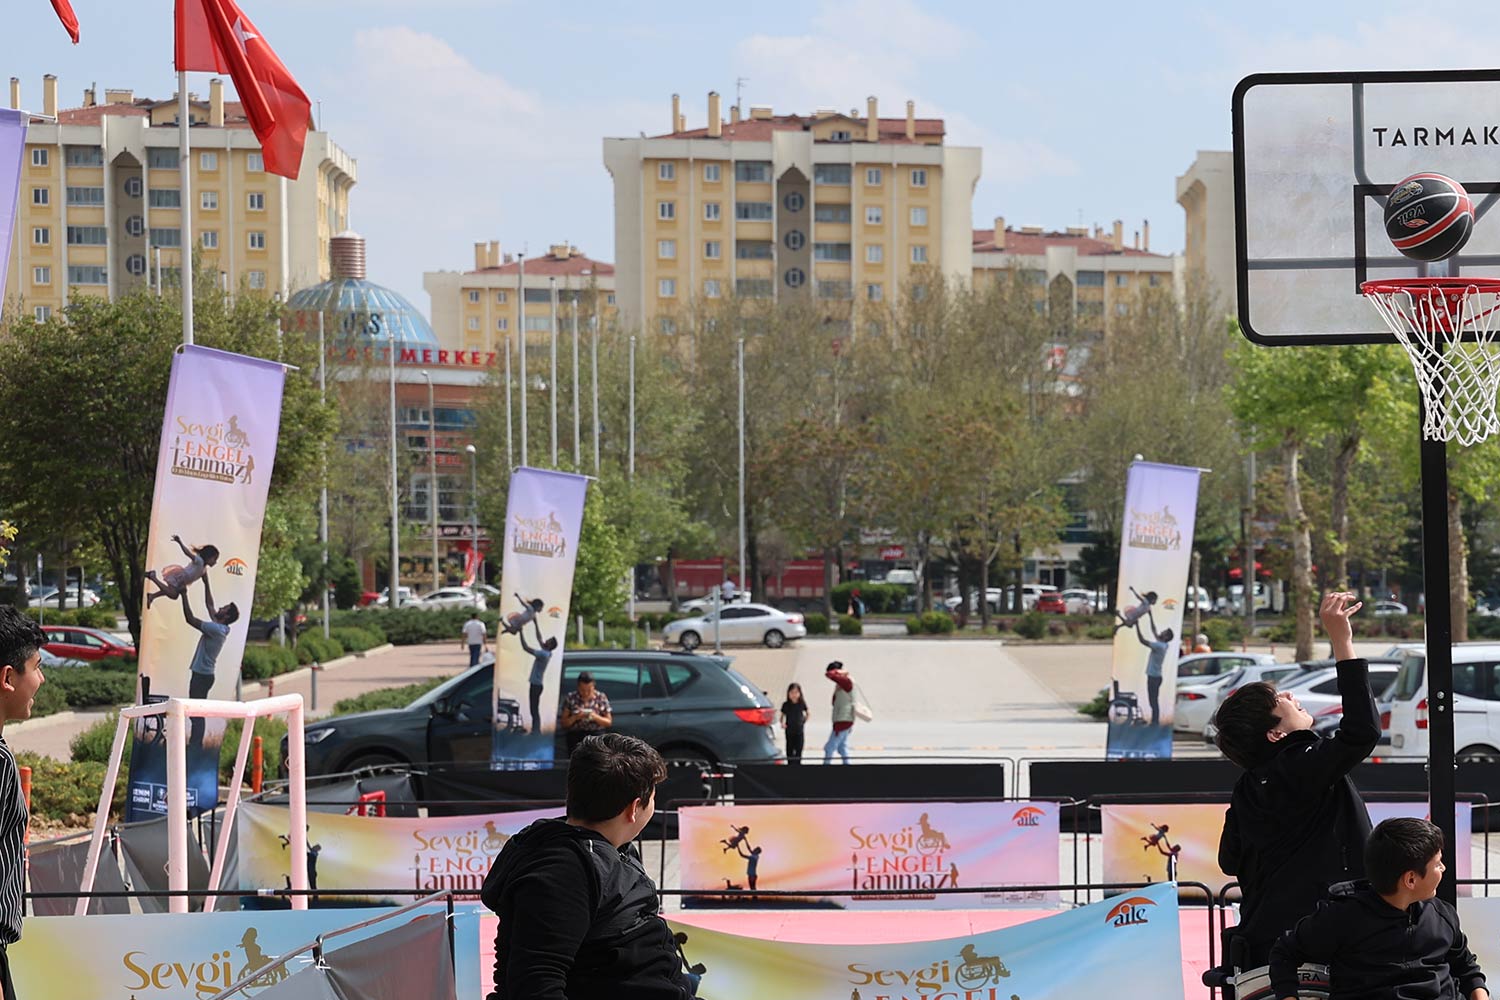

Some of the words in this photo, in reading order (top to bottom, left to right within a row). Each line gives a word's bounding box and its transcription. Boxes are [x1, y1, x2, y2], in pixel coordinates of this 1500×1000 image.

[1373, 126, 1499, 147] TARMAK
[176, 416, 223, 445] Sevgi
[185, 440, 246, 465] ENGEL
[412, 829, 479, 858] Sevgi
[850, 826, 913, 855] Sevgi
[867, 855, 950, 874] ENGEL
[1114, 904, 1147, 927] aile
[123, 951, 231, 1000] Sevgi
[848, 960, 949, 994] Sevgi
